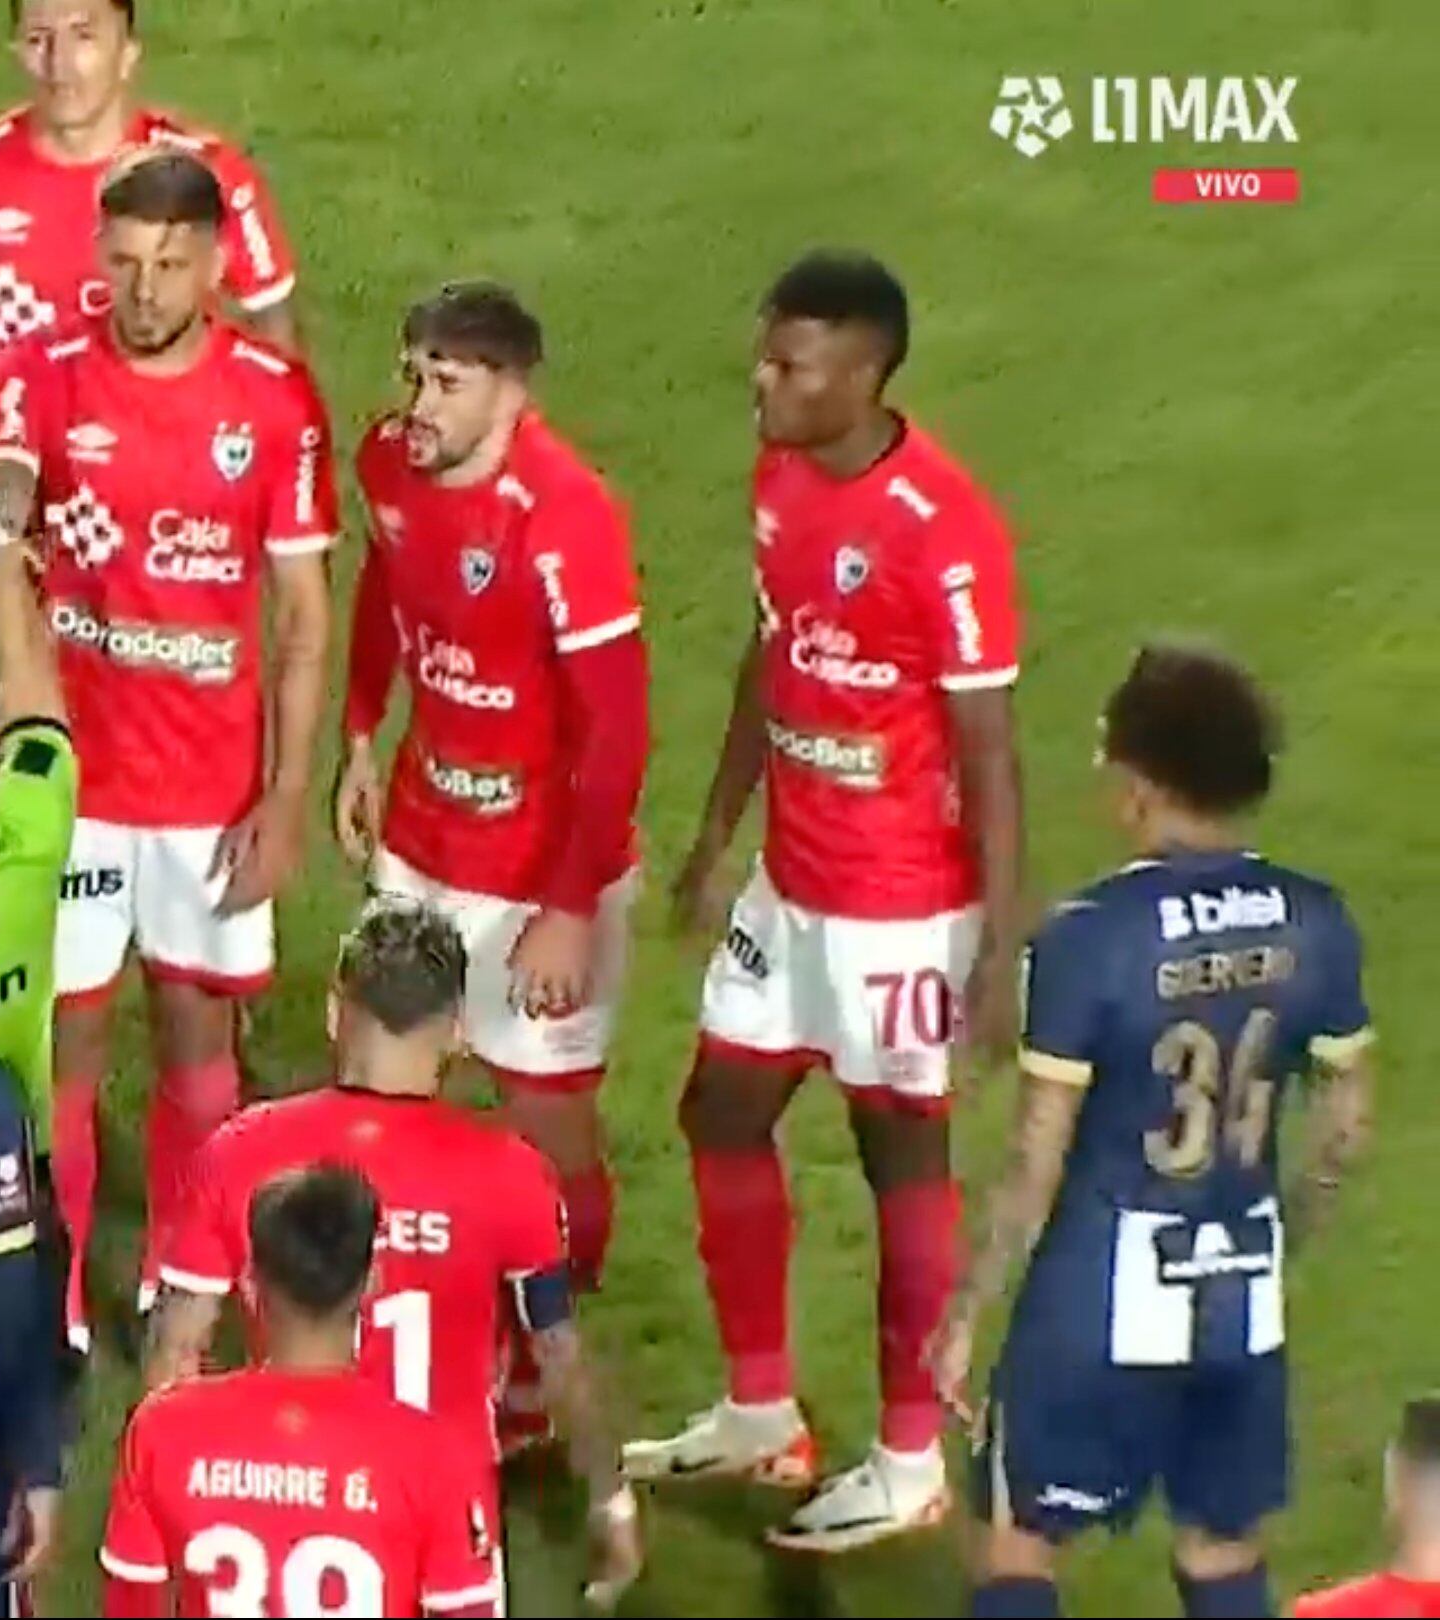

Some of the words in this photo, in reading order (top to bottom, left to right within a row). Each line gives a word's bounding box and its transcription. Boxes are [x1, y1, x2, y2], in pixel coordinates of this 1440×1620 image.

[420, 654, 514, 710] Cusco
[791, 636, 900, 688] Cusco
[864, 966, 953, 1048] 70
[1143, 1007, 1276, 1178] 34
[372, 1290, 430, 1412] 1
[187, 1458, 326, 1510] AGUIRRE
[344, 1470, 377, 1514] G.
